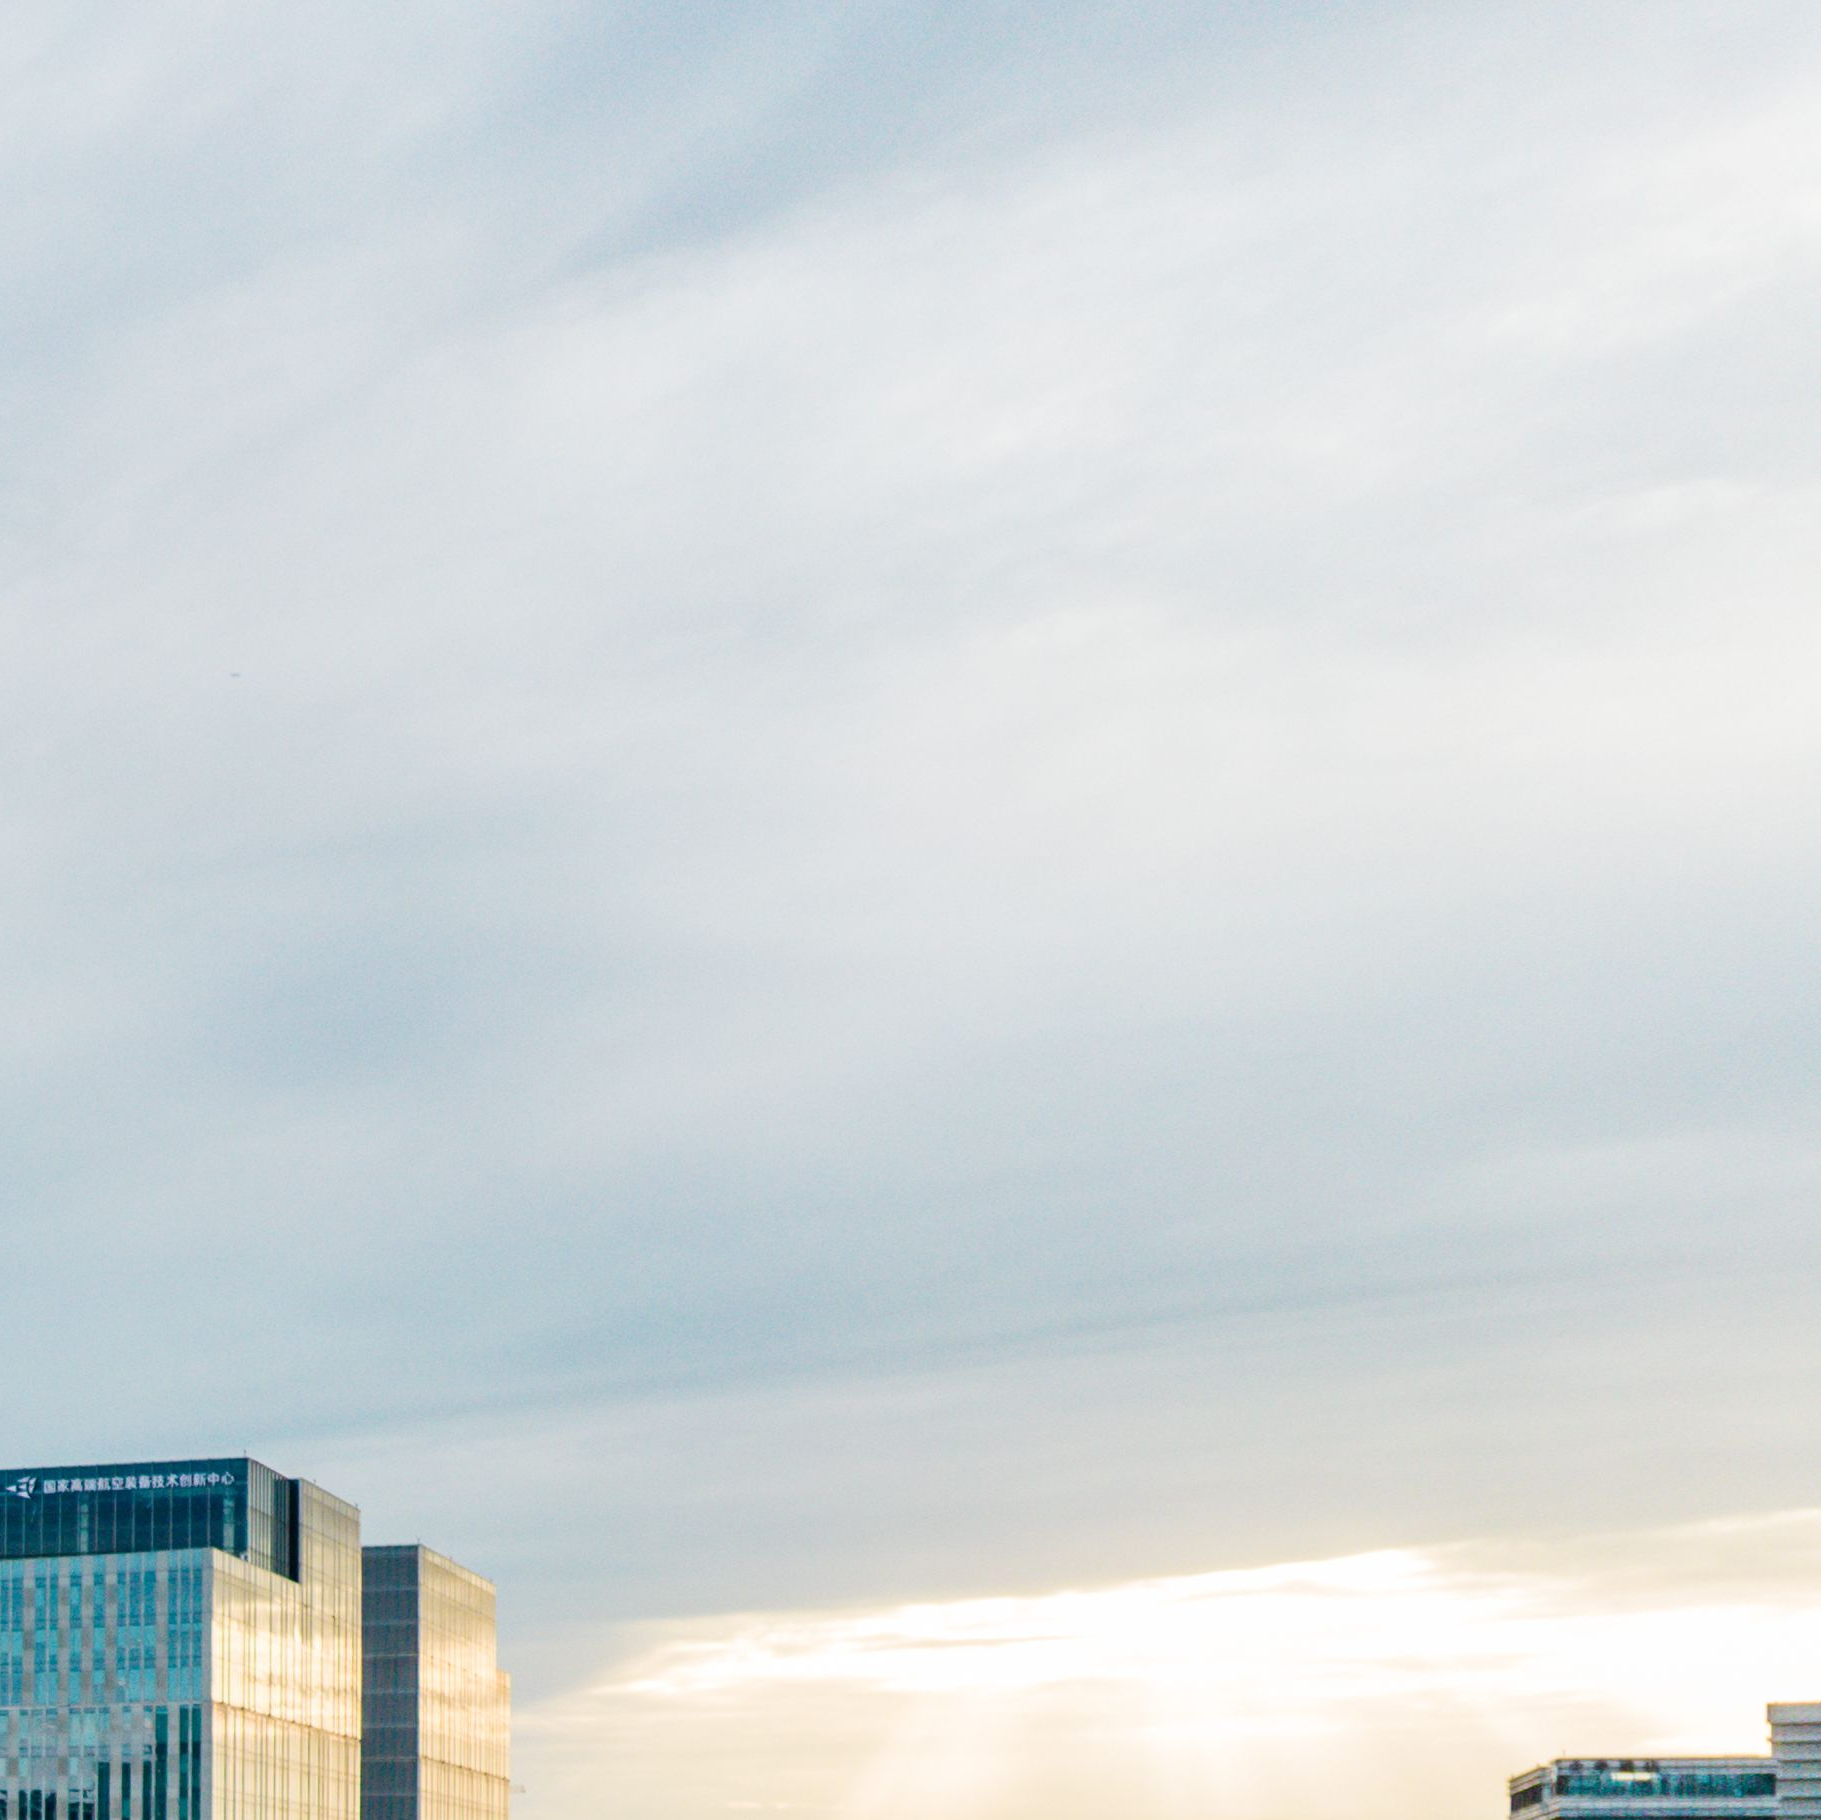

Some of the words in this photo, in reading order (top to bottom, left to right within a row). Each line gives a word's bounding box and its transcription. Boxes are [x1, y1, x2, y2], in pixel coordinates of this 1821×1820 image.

[43, 1472, 235, 1495] 国家高端航空装备技术创新中心
